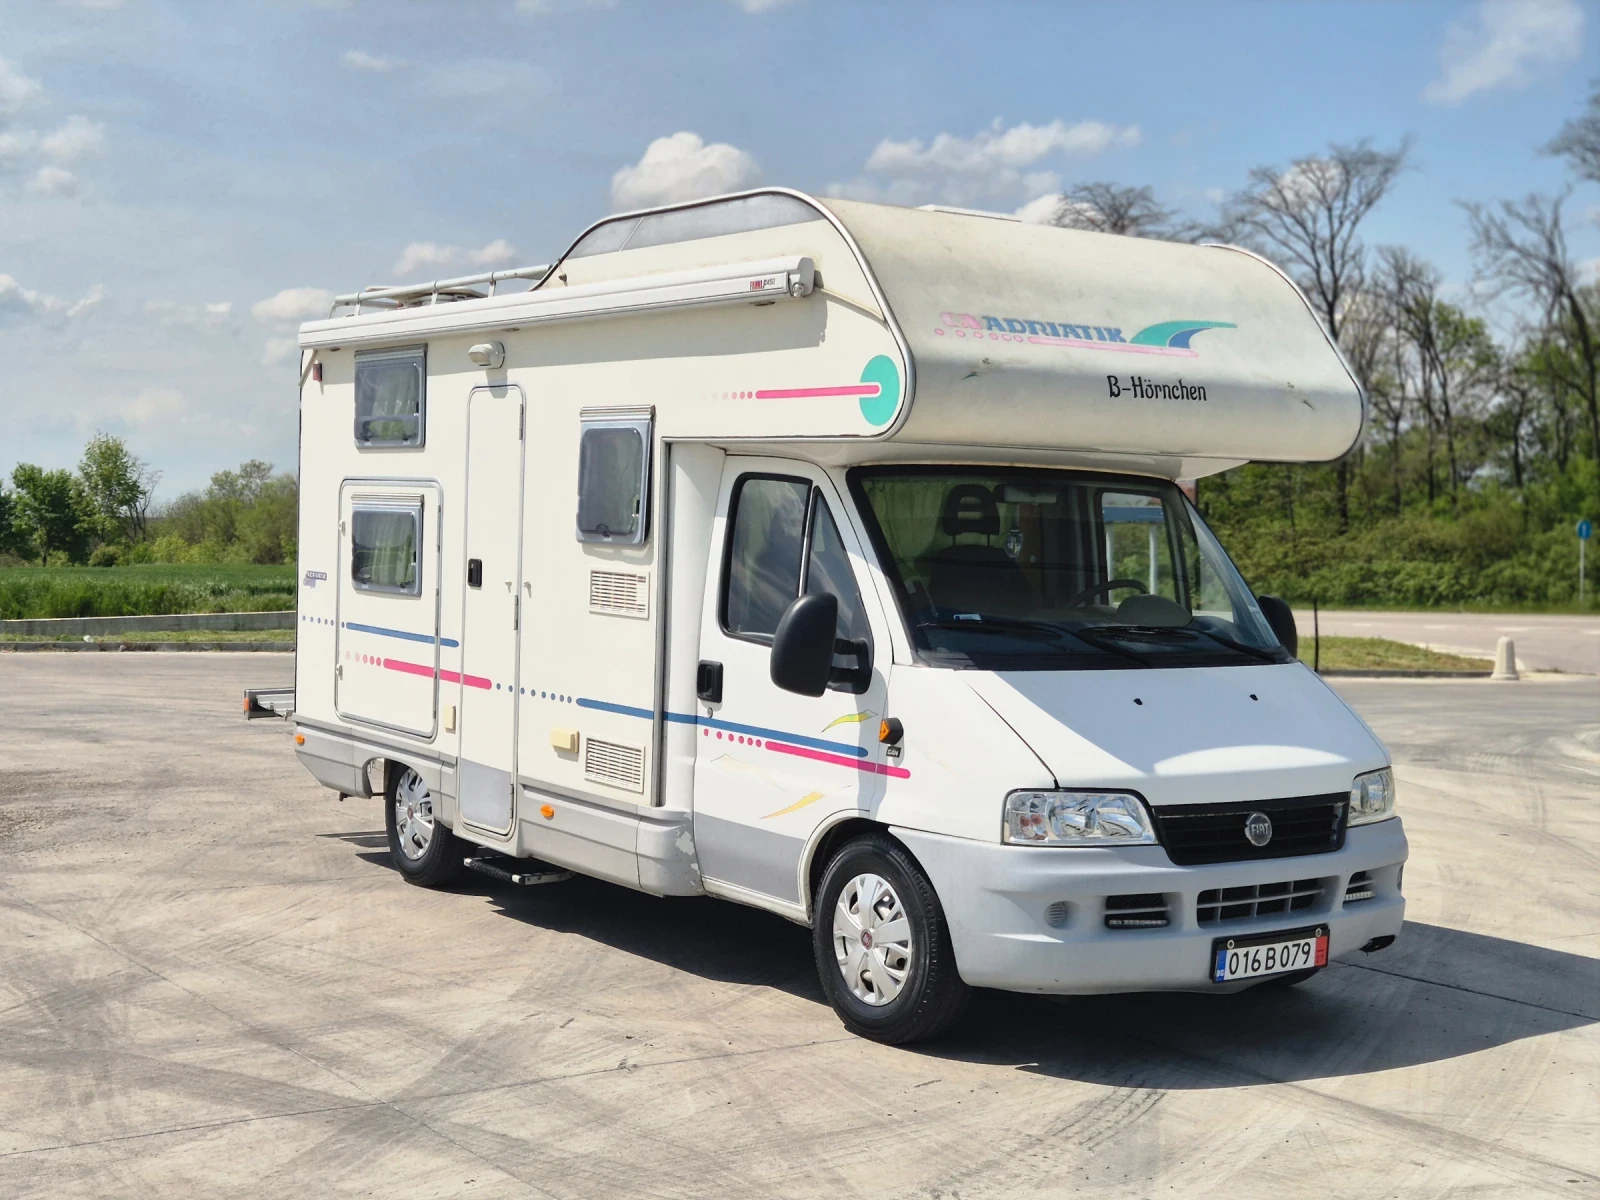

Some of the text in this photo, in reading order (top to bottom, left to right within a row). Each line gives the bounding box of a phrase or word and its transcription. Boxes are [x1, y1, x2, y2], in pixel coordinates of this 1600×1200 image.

[981, 315, 1128, 343] ADRIATIK
[1106, 375, 1208, 401] B-Hörnchen
[1251, 823, 1269, 835] FIAT
[1229, 942, 1311, 975] 016B079
